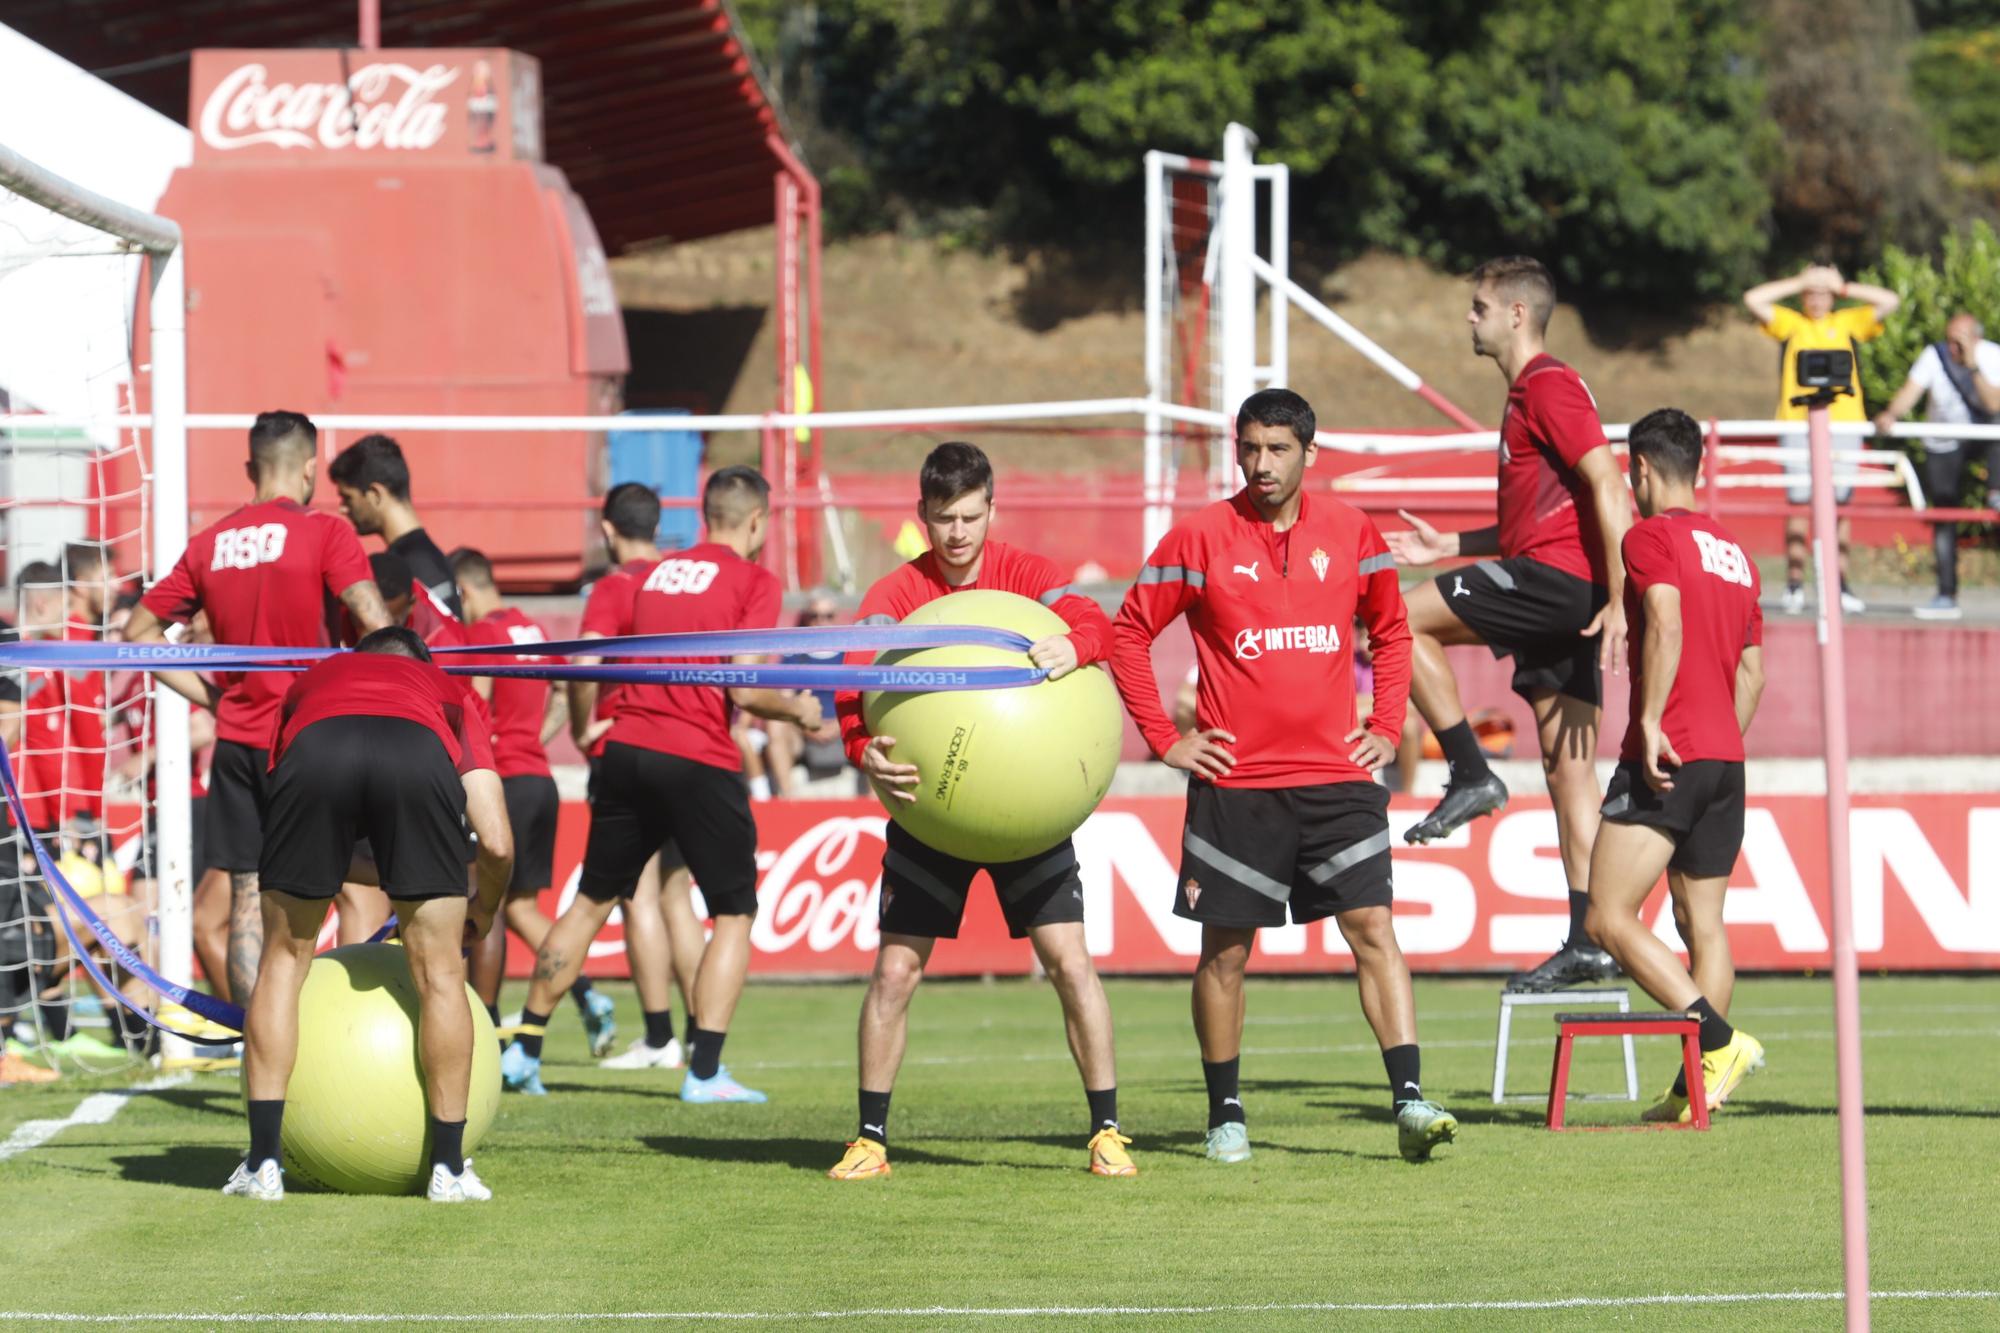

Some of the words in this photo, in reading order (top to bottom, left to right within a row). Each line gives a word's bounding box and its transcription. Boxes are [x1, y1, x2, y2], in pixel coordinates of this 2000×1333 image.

[210, 523, 288, 572] RSG
[1264, 625, 1340, 650] INTEGRA
[936, 726, 966, 800] BOOMERANG
[1073, 807, 2000, 954] NSSAN
